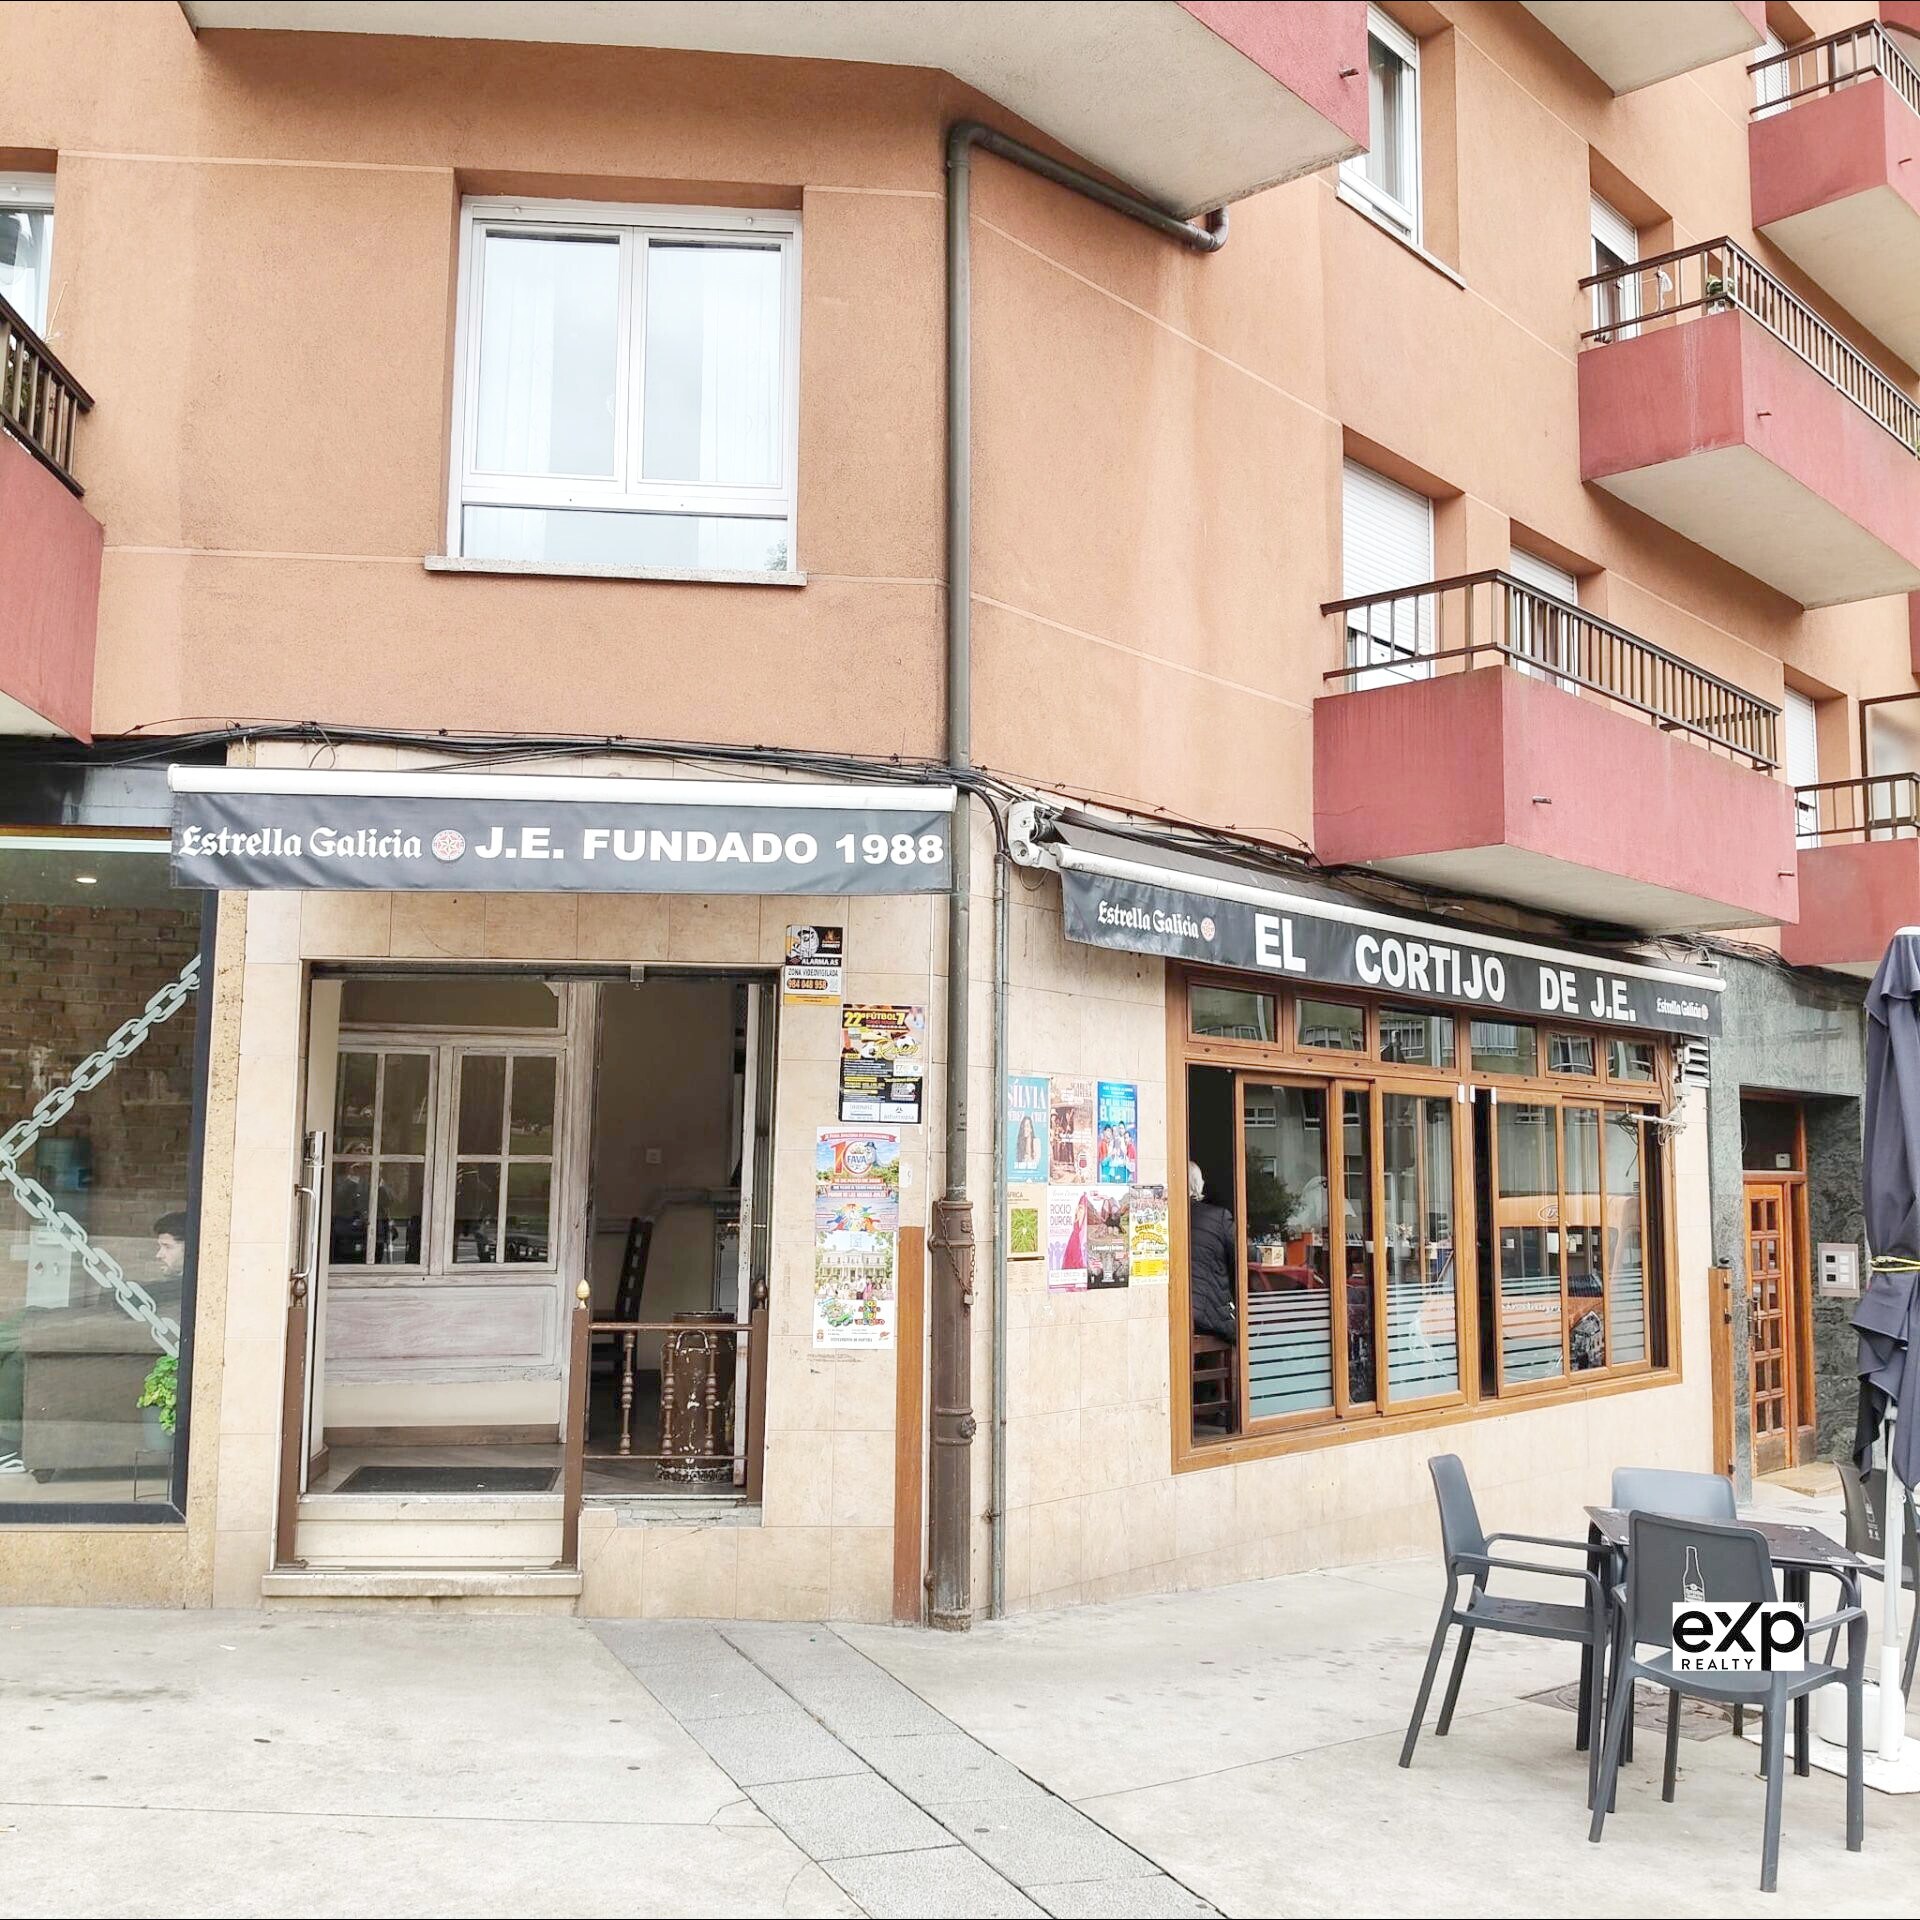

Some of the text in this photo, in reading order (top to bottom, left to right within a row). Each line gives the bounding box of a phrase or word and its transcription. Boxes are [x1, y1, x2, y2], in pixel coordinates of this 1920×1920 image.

[178, 825, 422, 858] Estrella Galicia
[475, 826, 944, 865] J.E. FUNDADO 1988
[1098, 900, 1199, 939] Estrella Galicia
[1254, 912, 1637, 1022] EL CORTIJO DE J.E.
[865, 1011, 897, 1021] FÚTBOL
[847, 1154, 867, 1164] FAVA
